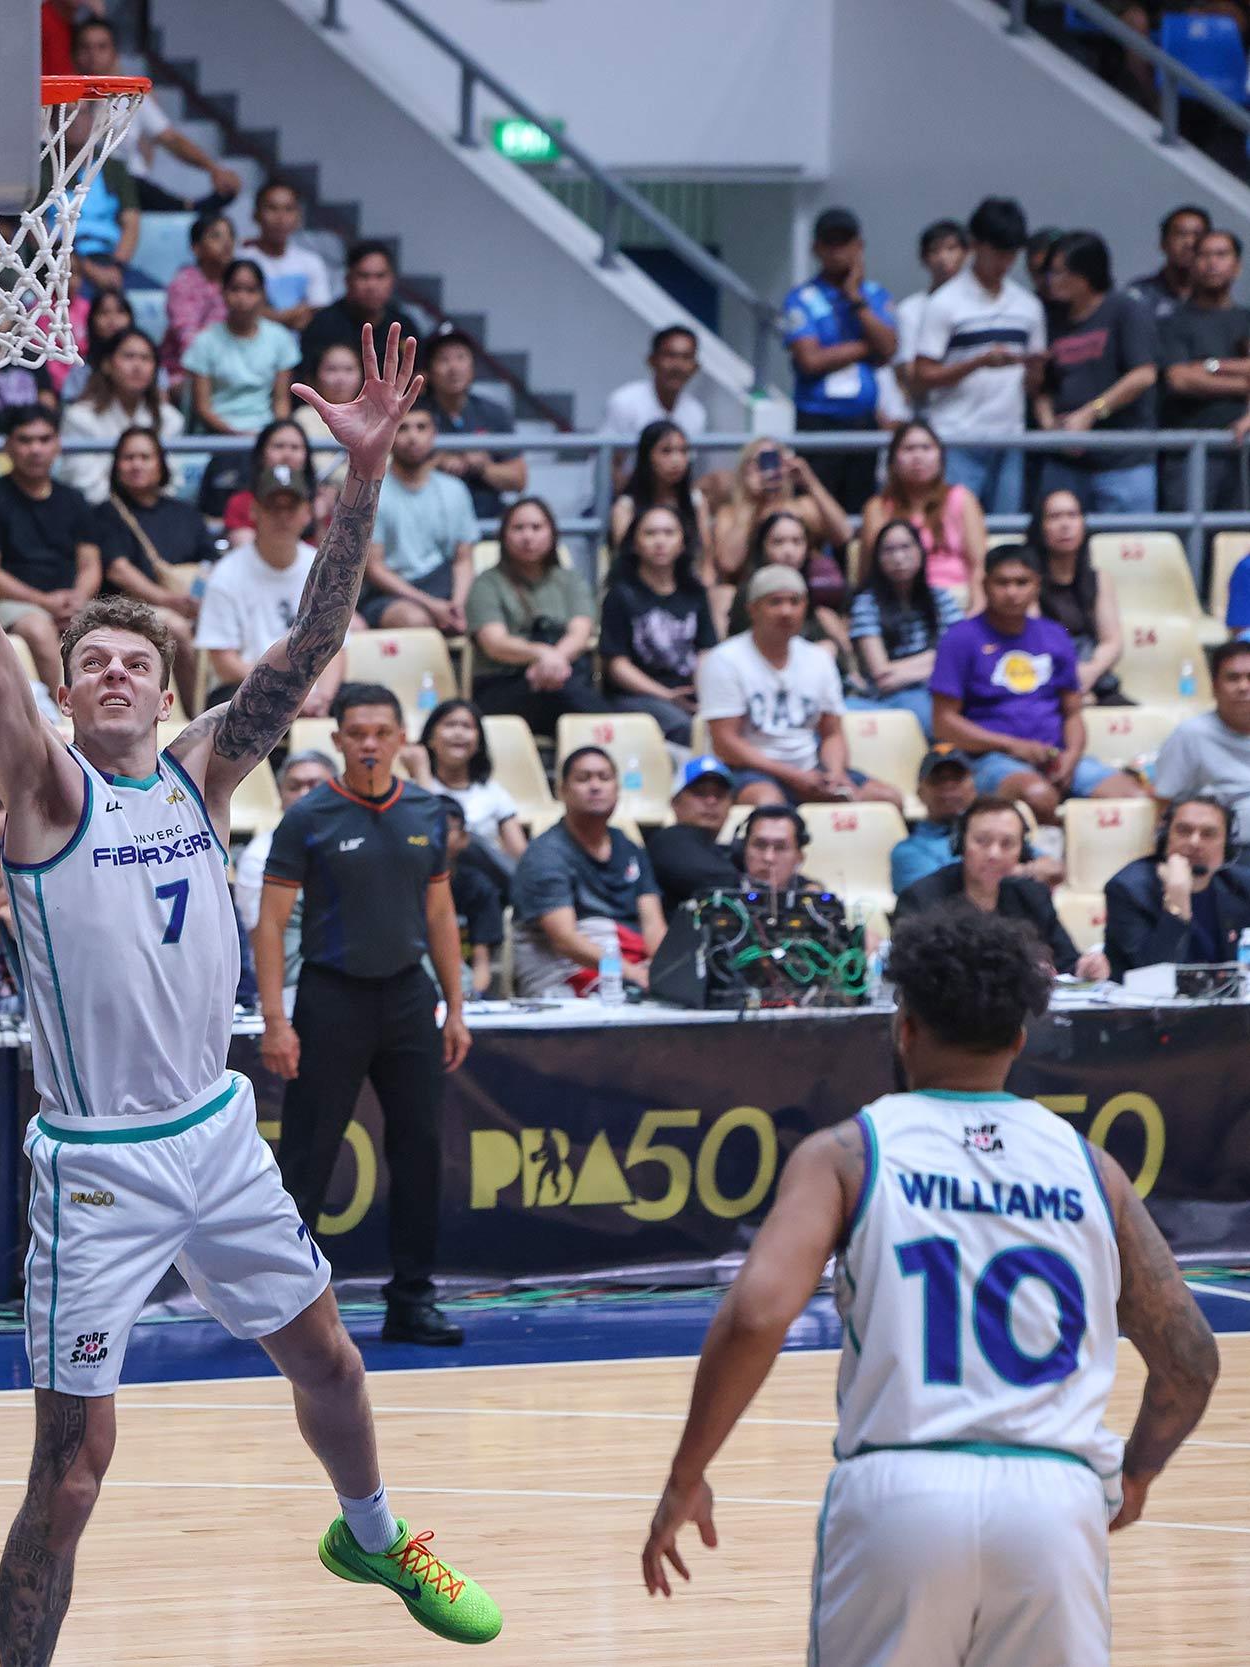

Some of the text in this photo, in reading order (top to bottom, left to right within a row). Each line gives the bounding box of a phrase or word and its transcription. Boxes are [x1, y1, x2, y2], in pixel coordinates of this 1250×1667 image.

[155, 877, 190, 945] 7
[470, 1106, 778, 1222] PBA50
[899, 1172, 1086, 1223] WILLIAMS
[75, 1332, 110, 1348] SURF
[893, 1234, 1087, 1389] 10
[70, 1347, 108, 1363] SAWA
